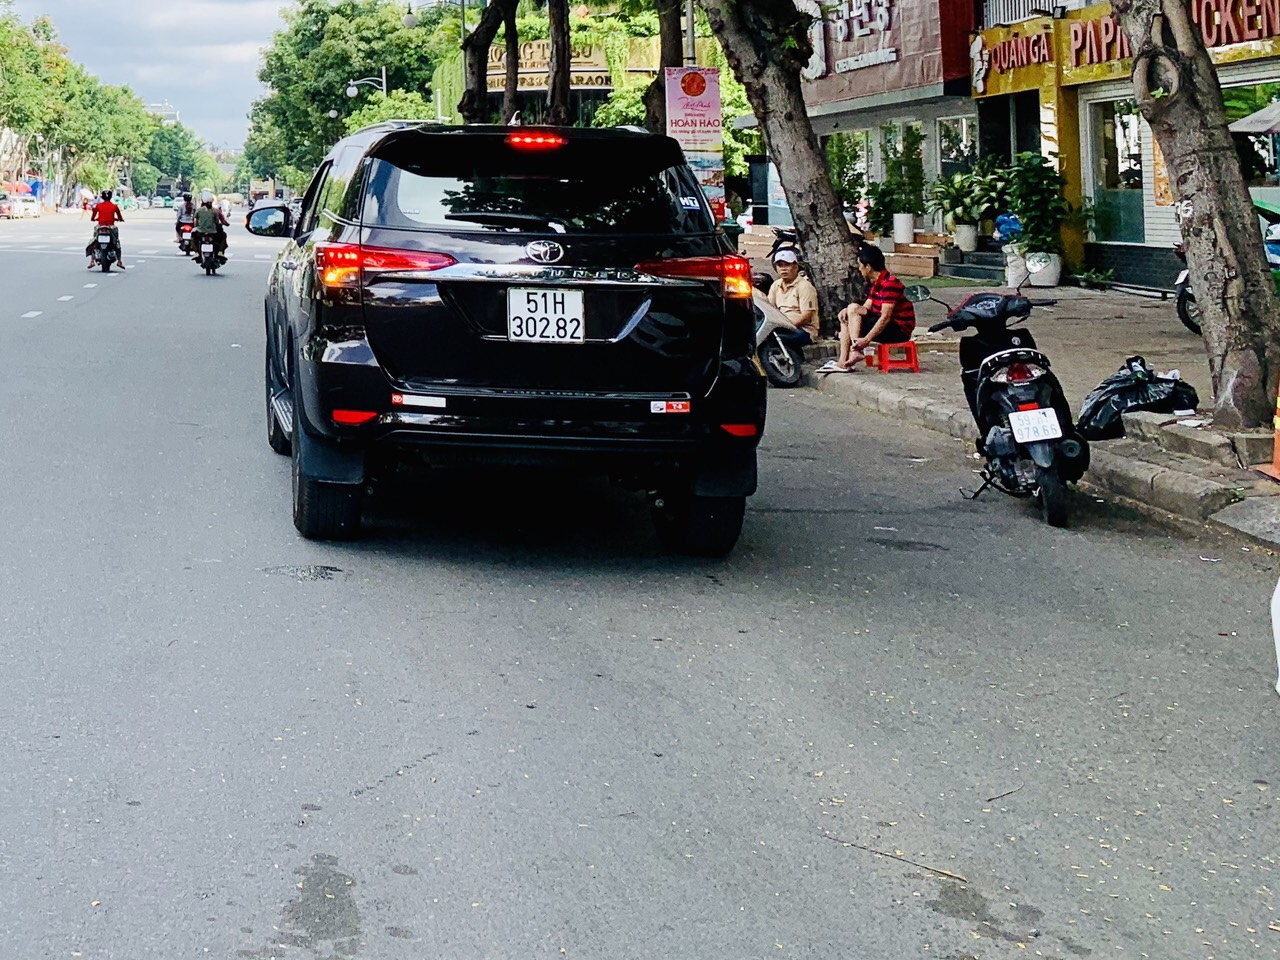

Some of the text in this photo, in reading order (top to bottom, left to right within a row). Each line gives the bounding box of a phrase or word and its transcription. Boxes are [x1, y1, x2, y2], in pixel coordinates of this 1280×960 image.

[526, 292, 565, 315] 51H
[512, 316, 581, 340] 302.82
[1017, 423, 1058, 440] 978.66
